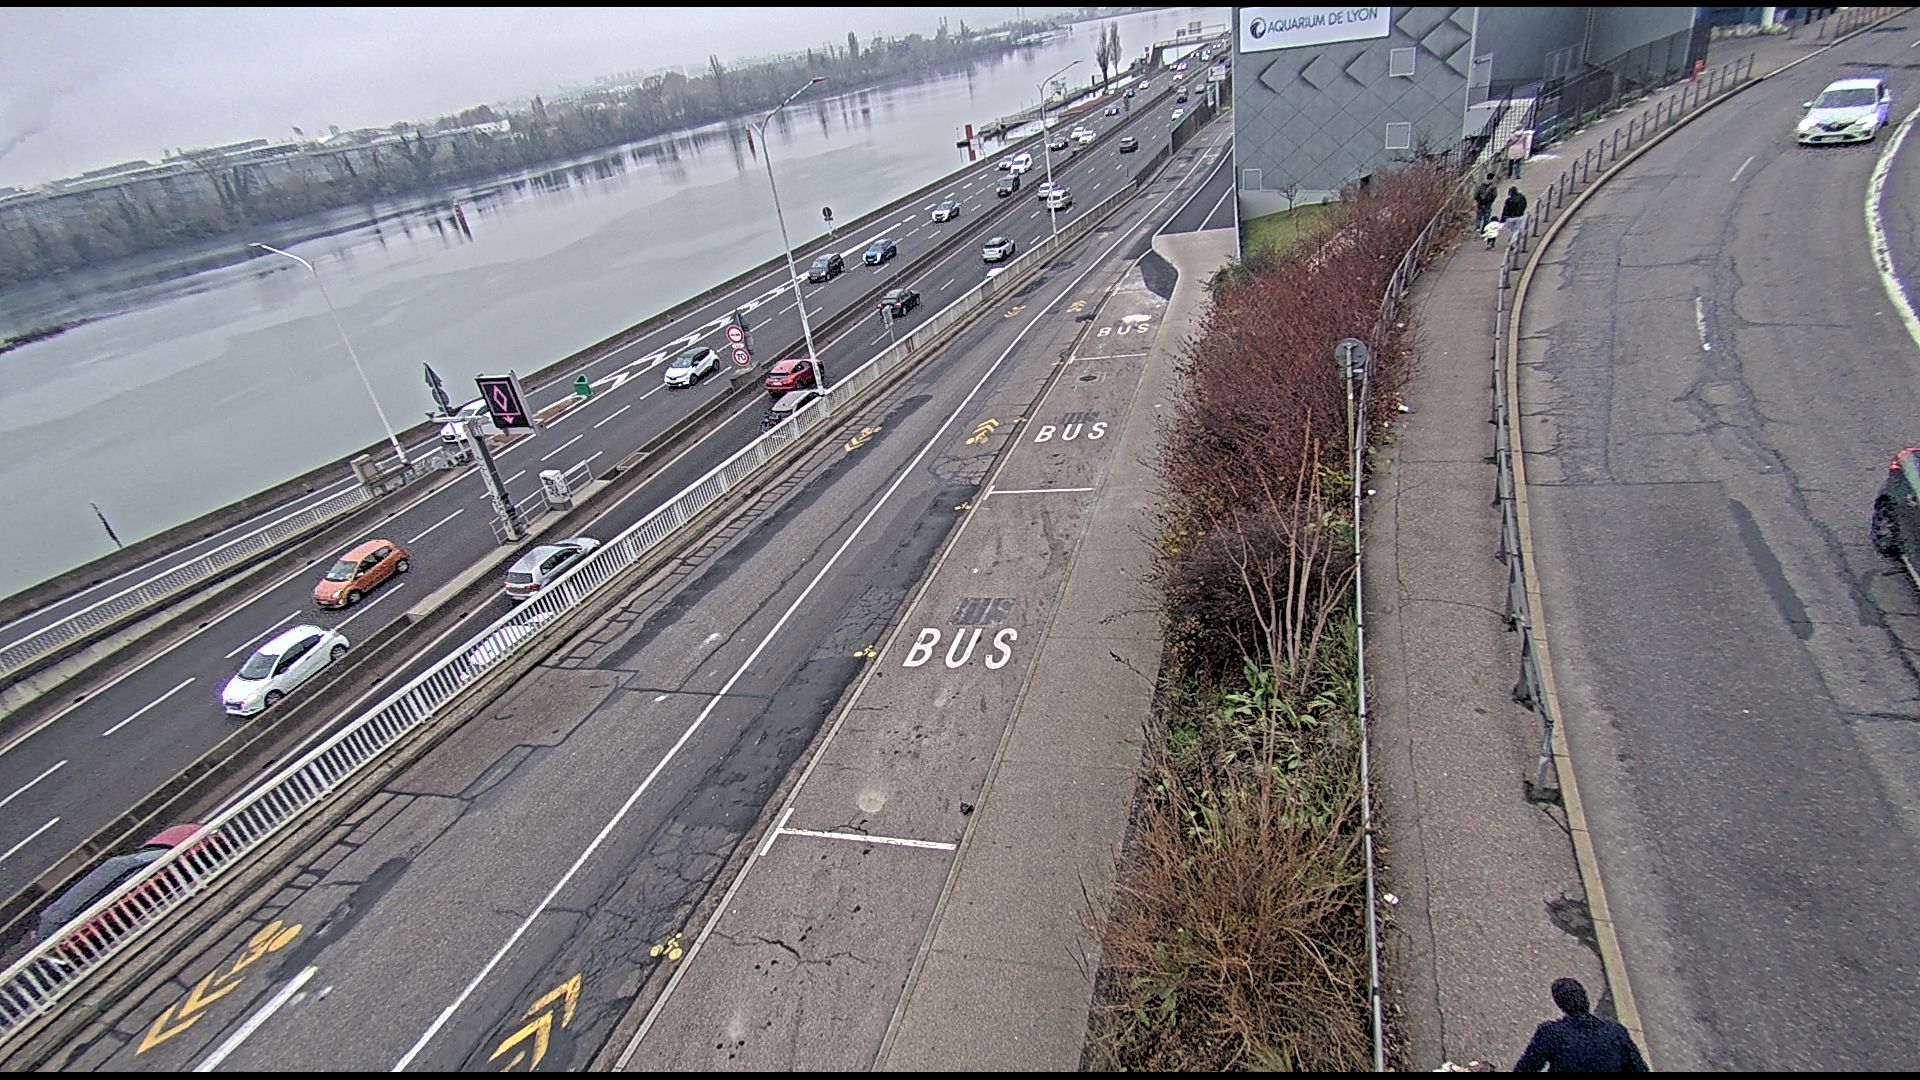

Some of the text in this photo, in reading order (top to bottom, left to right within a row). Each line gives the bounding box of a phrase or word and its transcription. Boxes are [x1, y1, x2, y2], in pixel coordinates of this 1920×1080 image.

[1267, 7, 1378, 33] AQUARIUM DE LYON
[1097, 323, 1150, 337] BUS
[736, 352, 747, 361] 70
[1034, 421, 1108, 443] BUS
[902, 627, 1018, 670] BUS
